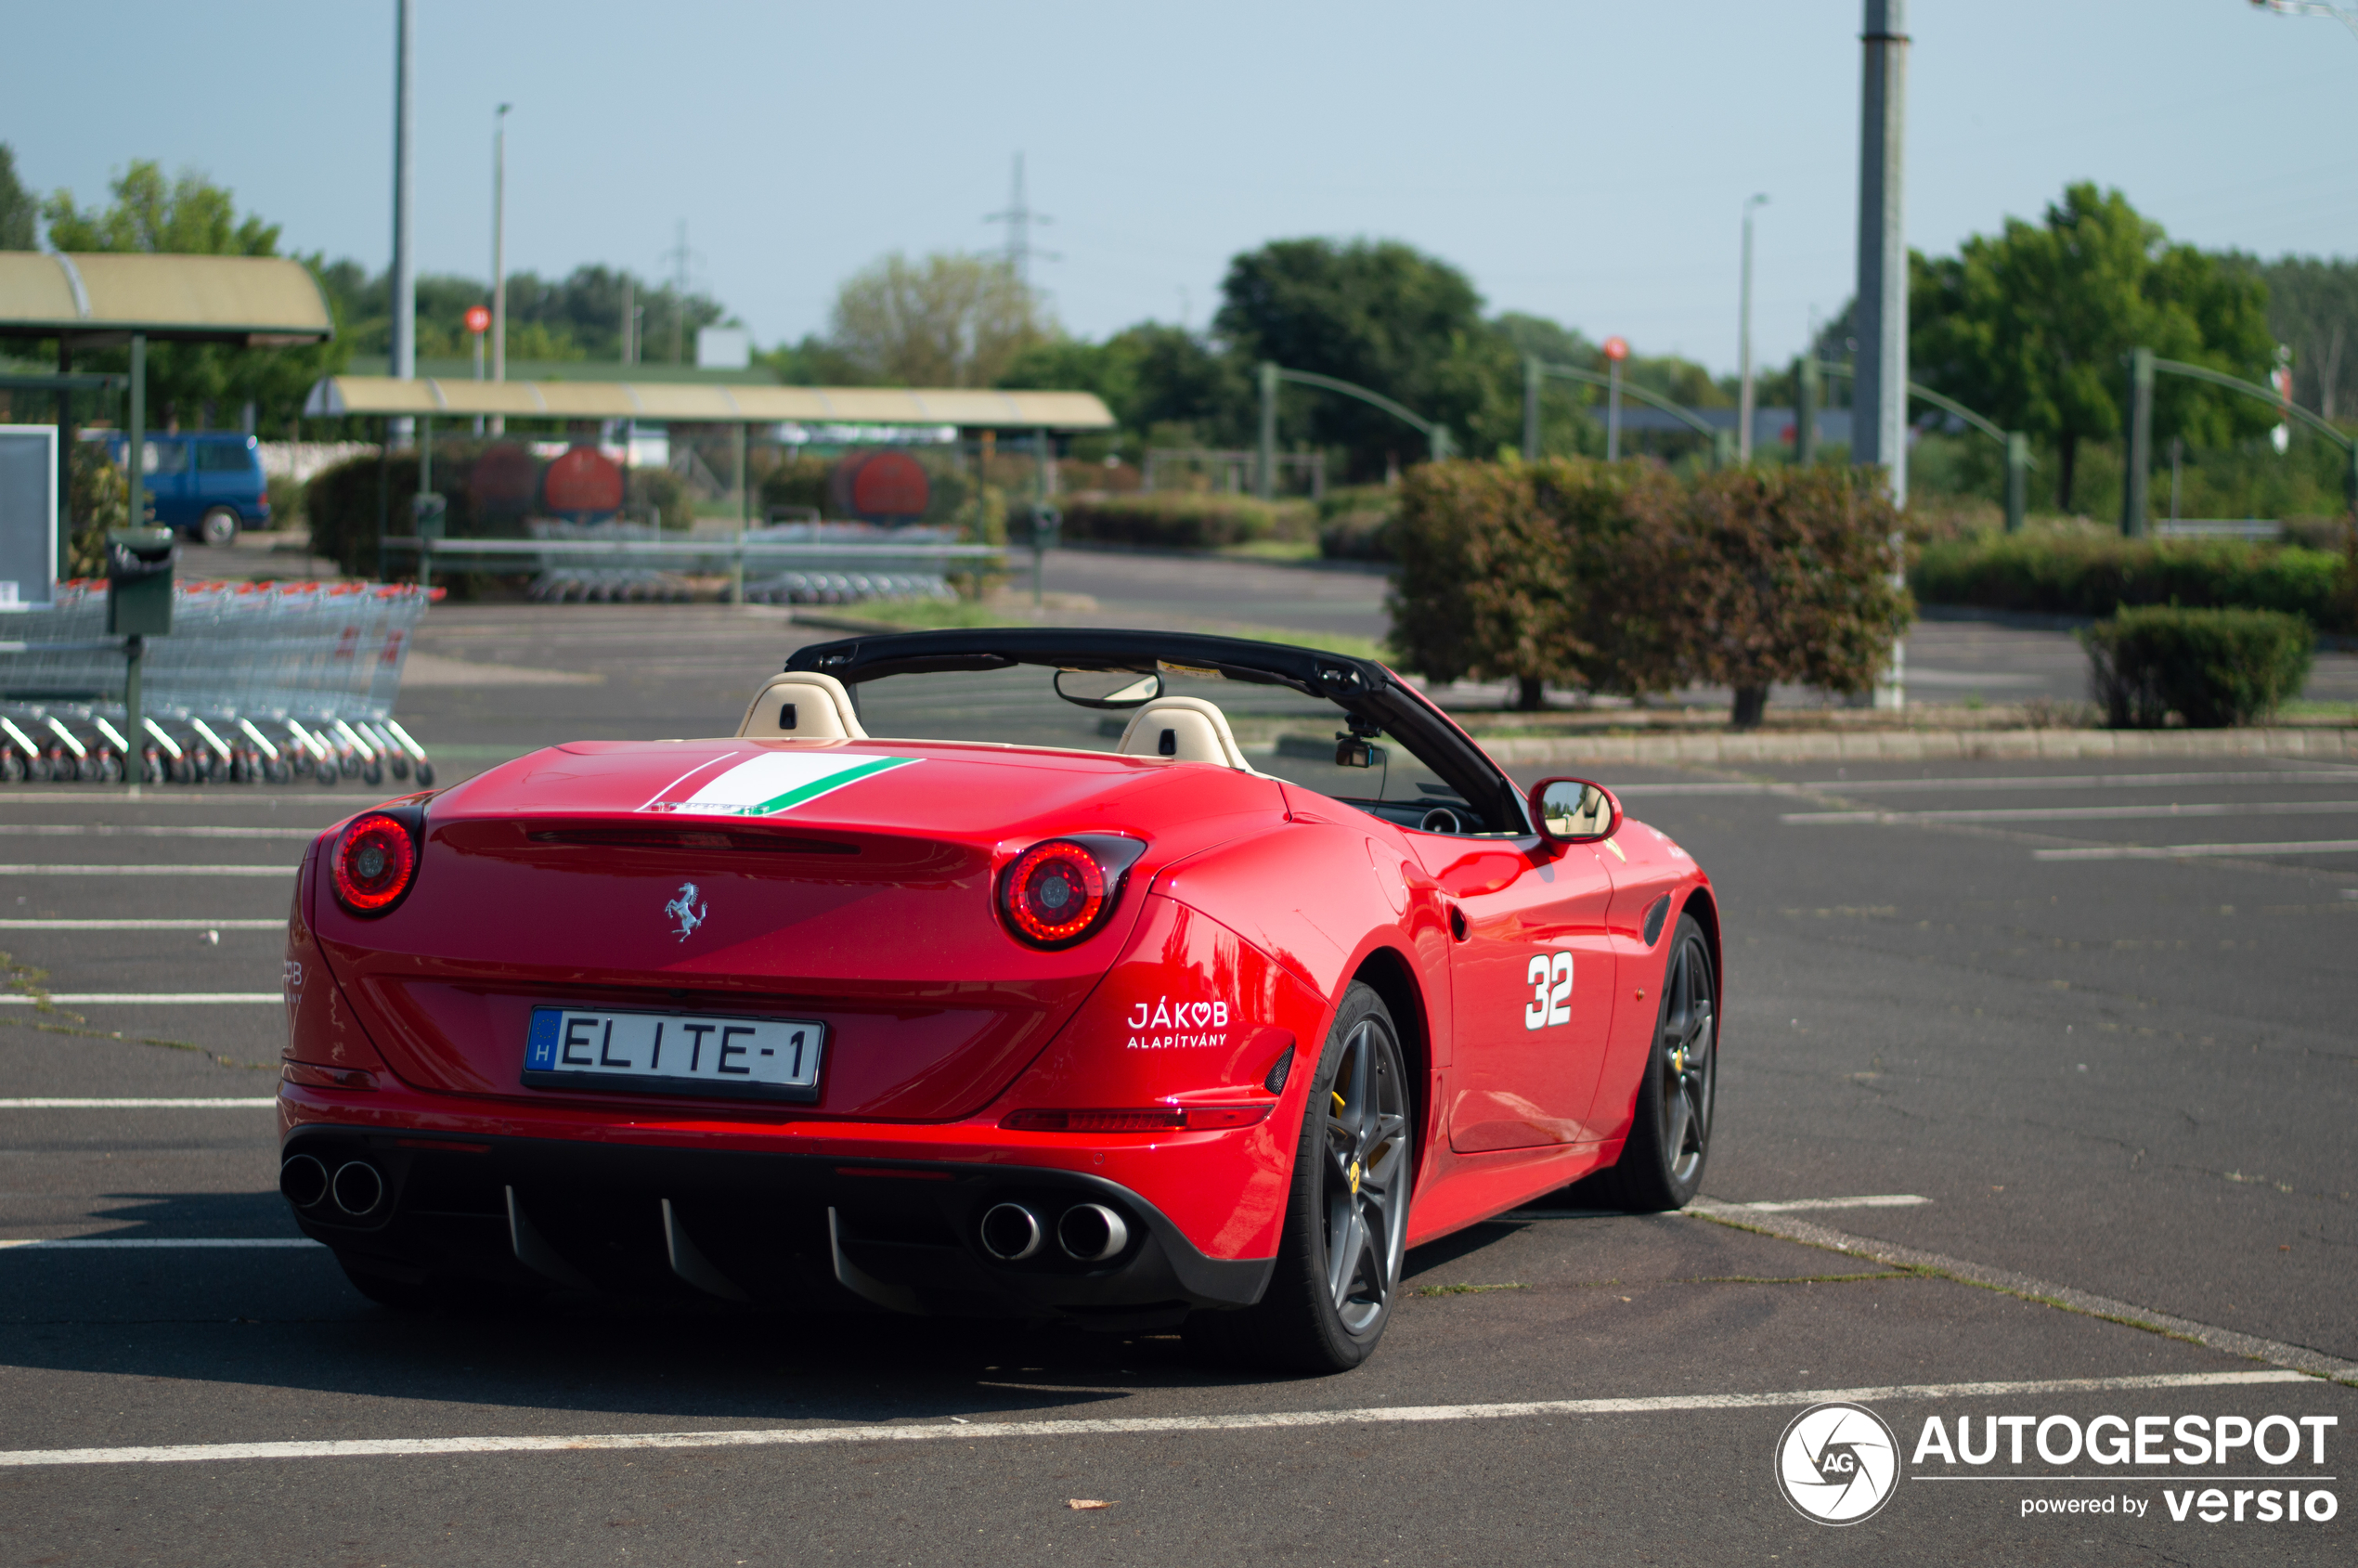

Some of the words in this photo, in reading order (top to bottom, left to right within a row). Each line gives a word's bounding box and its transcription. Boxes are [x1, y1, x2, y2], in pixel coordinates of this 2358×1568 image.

[1525, 951, 1574, 1031] 32
[1126, 1032, 1226, 1048] ALAPÍTVÁNY
[1337, 1004, 1357, 1043] PIRELLI
[535, 1044, 550, 1061] H
[562, 1017, 806, 1078] ELITE-1
